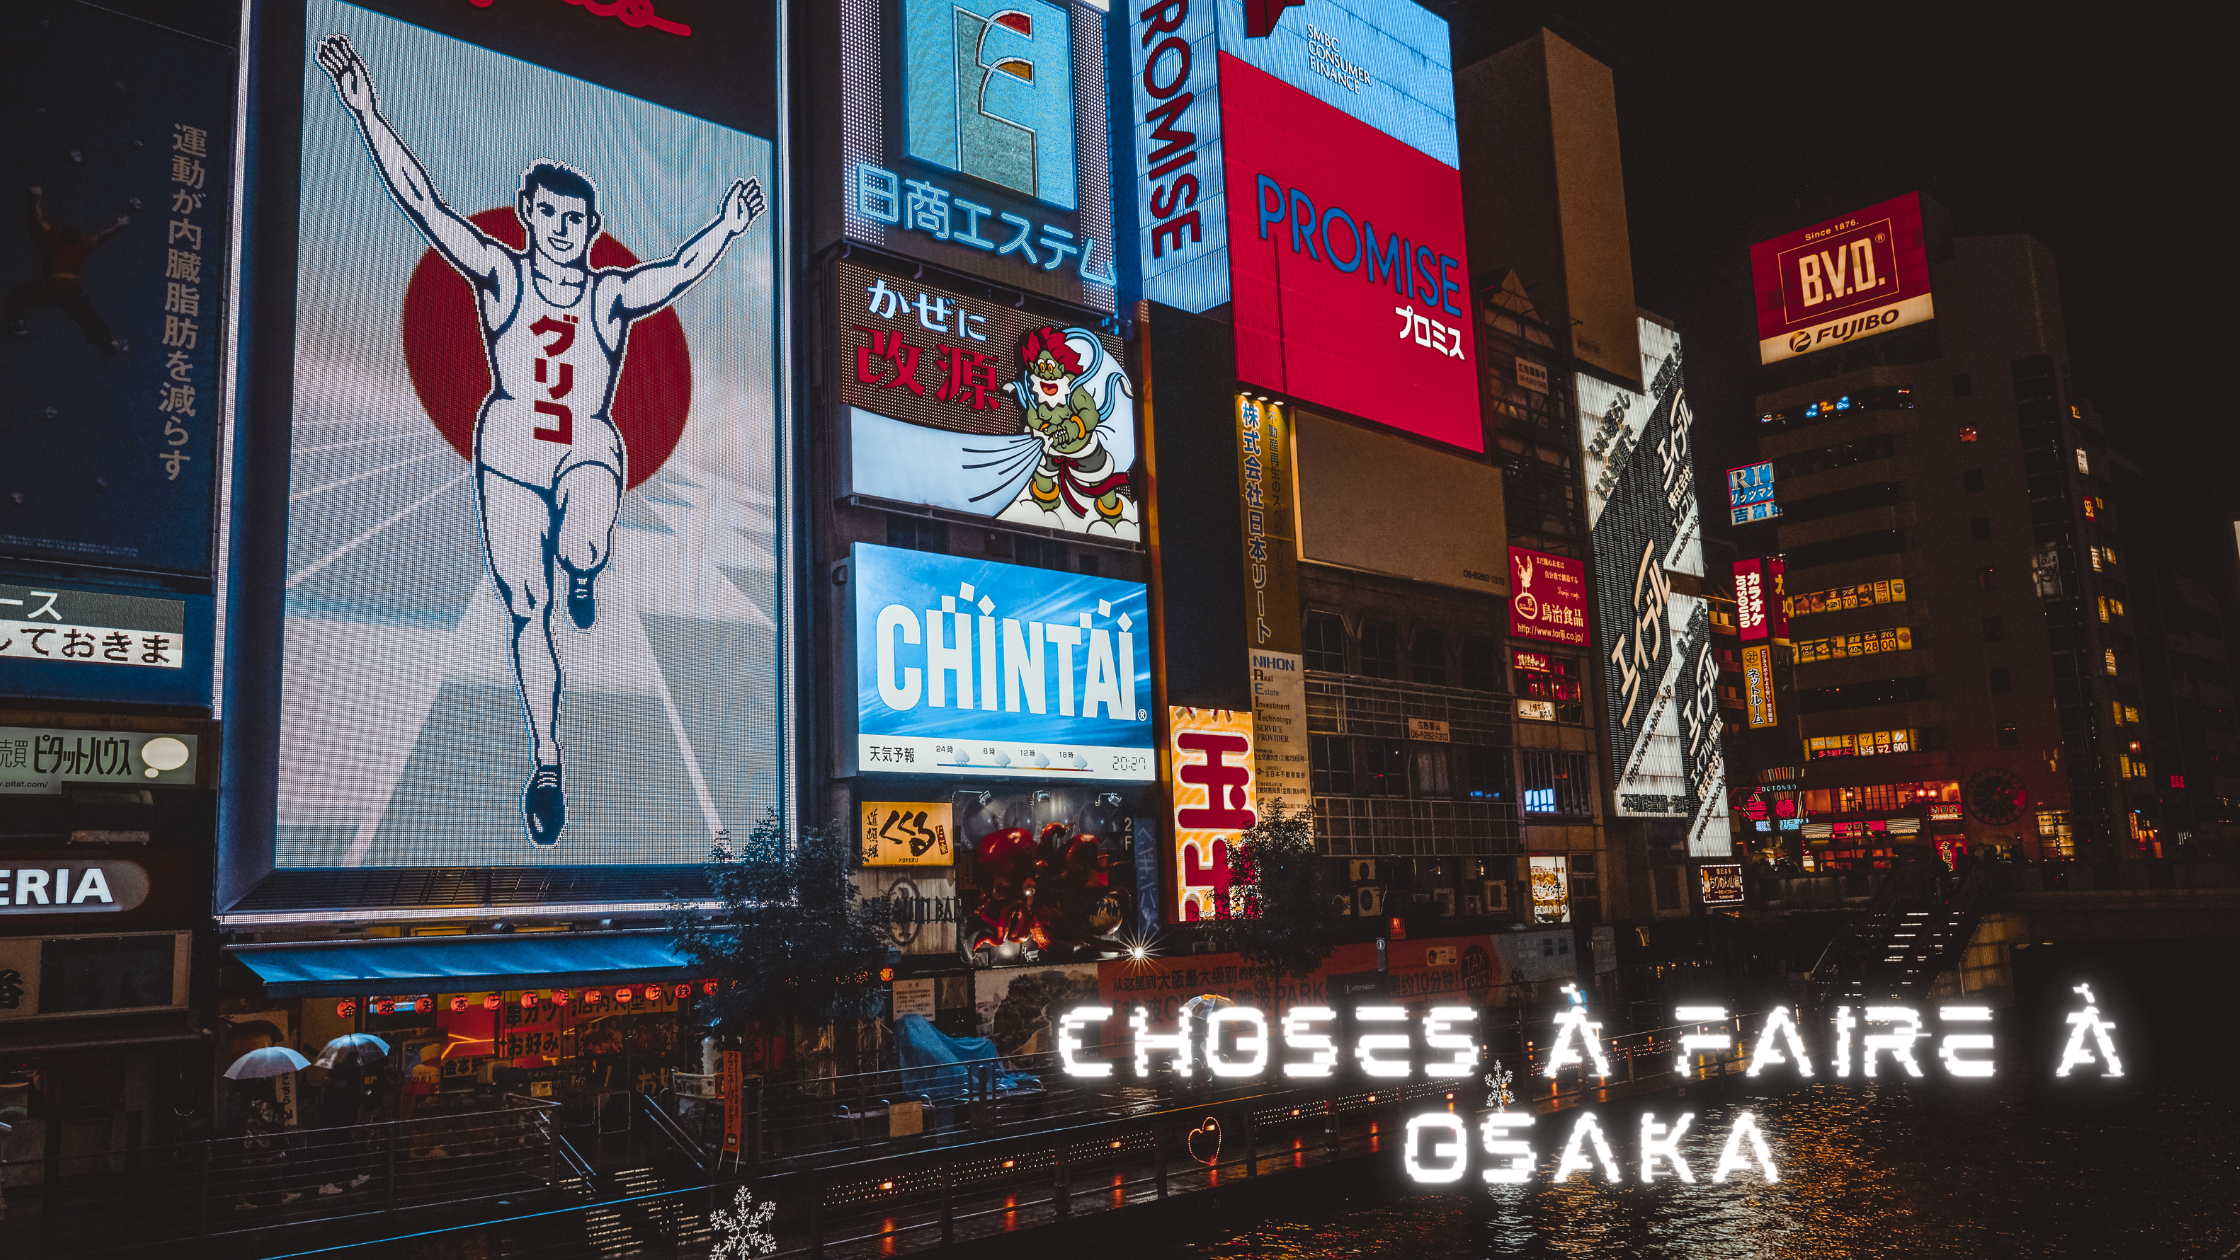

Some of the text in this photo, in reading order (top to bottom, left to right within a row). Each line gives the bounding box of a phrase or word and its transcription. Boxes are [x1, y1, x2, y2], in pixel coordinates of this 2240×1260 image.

[1307, 23, 1340, 53] SMBC
[1308, 40, 1372, 86] CONSUMER
[1309, 56, 1361, 95] FINANCE
[857, 163, 1117, 286] 日商エステム
[1257, 172, 1462, 318] PROMISE
[1805, 227, 1832, 241] Since
[1798, 237, 1886, 308] B.V.D.
[158, 122, 208, 482] 運動が内臓脂肪を減らす
[867, 279, 987, 341] かぜに
[1395, 305, 1465, 361] プロミス
[1816, 309, 1900, 345] FUJIBO
[529, 314, 579, 445] グリコ
[854, 325, 1001, 412] 改源
[1656, 398, 1694, 475] エイブル
[1667, 464, 1693, 511] 株式会社
[1241, 401, 1271, 643] 株式会社日本リート
[1542, 602, 1584, 628] 鳥治食品
[1735, 575, 1751, 628] JOYSOUND
[1747, 572, 1765, 626] カラオケ
[1611, 556, 1672, 698] エイブル
[876, 581, 1137, 721] CHINTAI
[1253, 655, 1295, 671] NIHON
[1255, 683, 1280, 696] Estate
[1255, 696, 1290, 711] Investment
[1683, 652, 1720, 738] エイブル
[1747, 668, 1765, 725] ネットルーム
[1255, 709, 1292, 725] Technology
[1256, 725, 1284, 734] SERVICE
[1257, 734, 1290, 743] PROVIDER
[34, 734, 132, 775] ピタットハウス
[869, 746, 915, 764] 天気予報
[936, 745, 954, 754] 24時
[983, 747, 996, 756] 6時
[1019, 749, 1036, 758] 12時
[1113, 756, 1147, 772] 20:27
[508, 1032, 559, 1057] お好み
